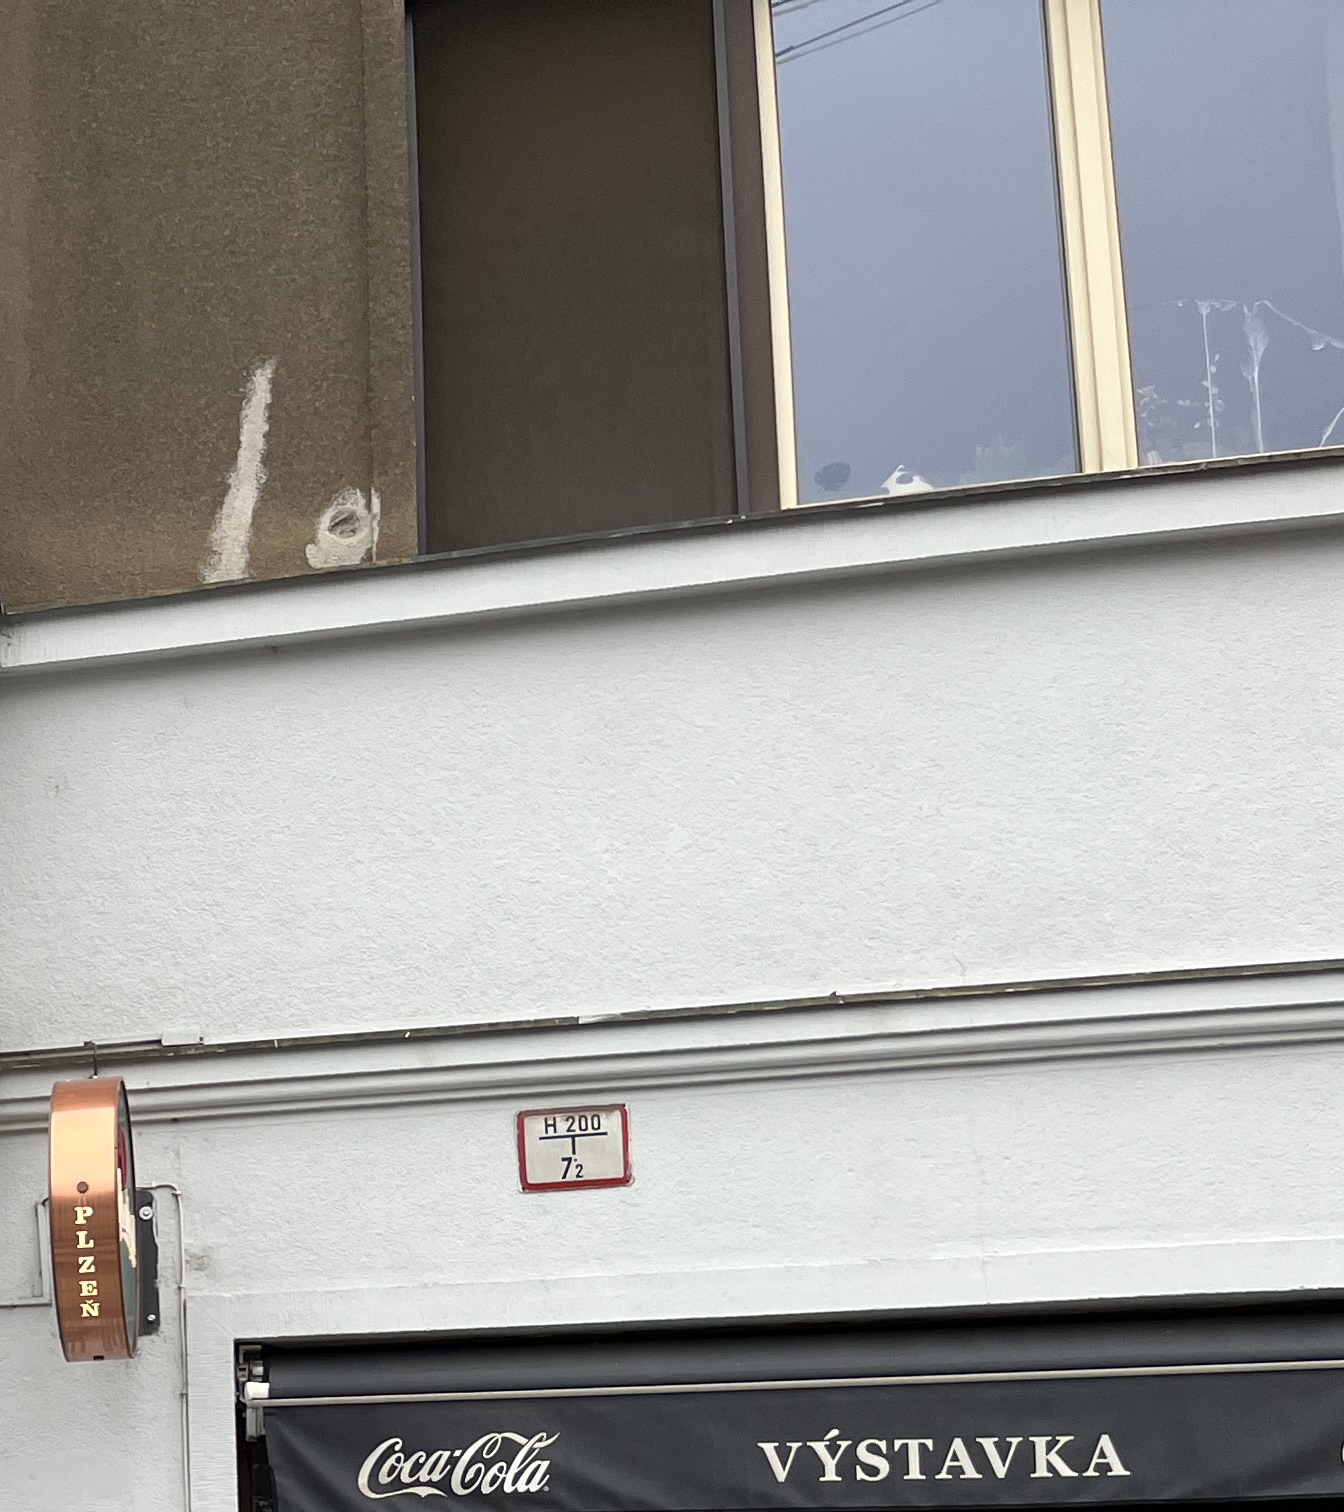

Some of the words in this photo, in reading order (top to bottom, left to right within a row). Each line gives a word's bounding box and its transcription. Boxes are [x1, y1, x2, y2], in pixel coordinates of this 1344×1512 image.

[544, 1116, 557, 1134] H
[566, 1114, 601, 1132] 200
[74, 1206, 100, 1318] PLZEŇ
[357, 1432, 560, 1498] Coca-Cola
[757, 1429, 1130, 1482] VÝSTAVKA
